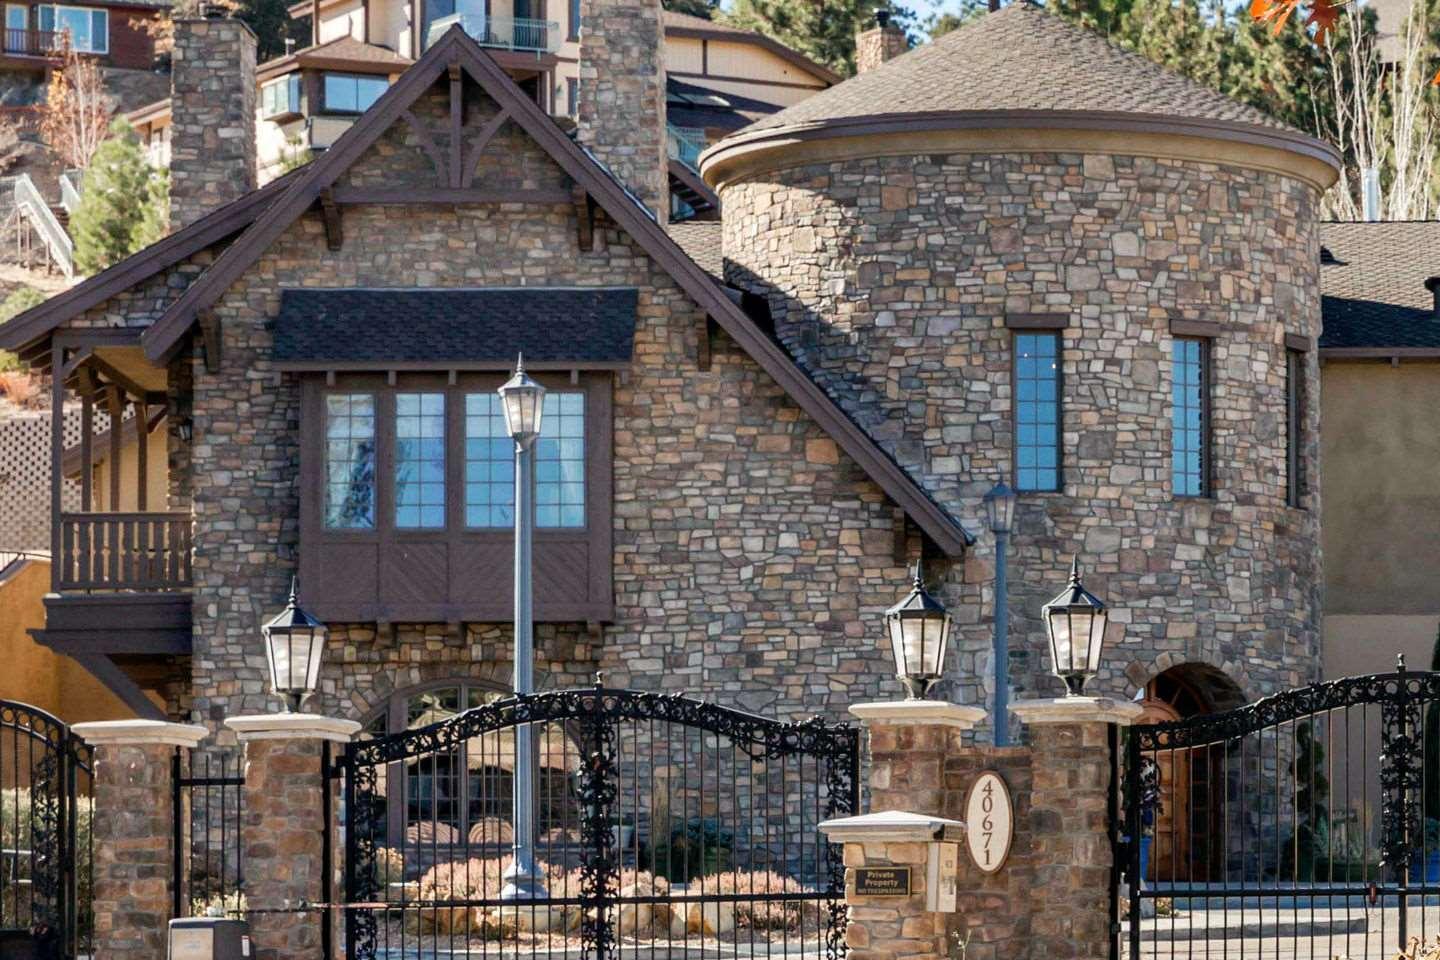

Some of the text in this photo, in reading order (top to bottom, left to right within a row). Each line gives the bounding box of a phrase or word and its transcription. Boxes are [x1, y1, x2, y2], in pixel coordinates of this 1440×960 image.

[982, 780, 993, 865] 40671
[867, 871, 895, 879] Private
[865, 879, 898, 888] Property
